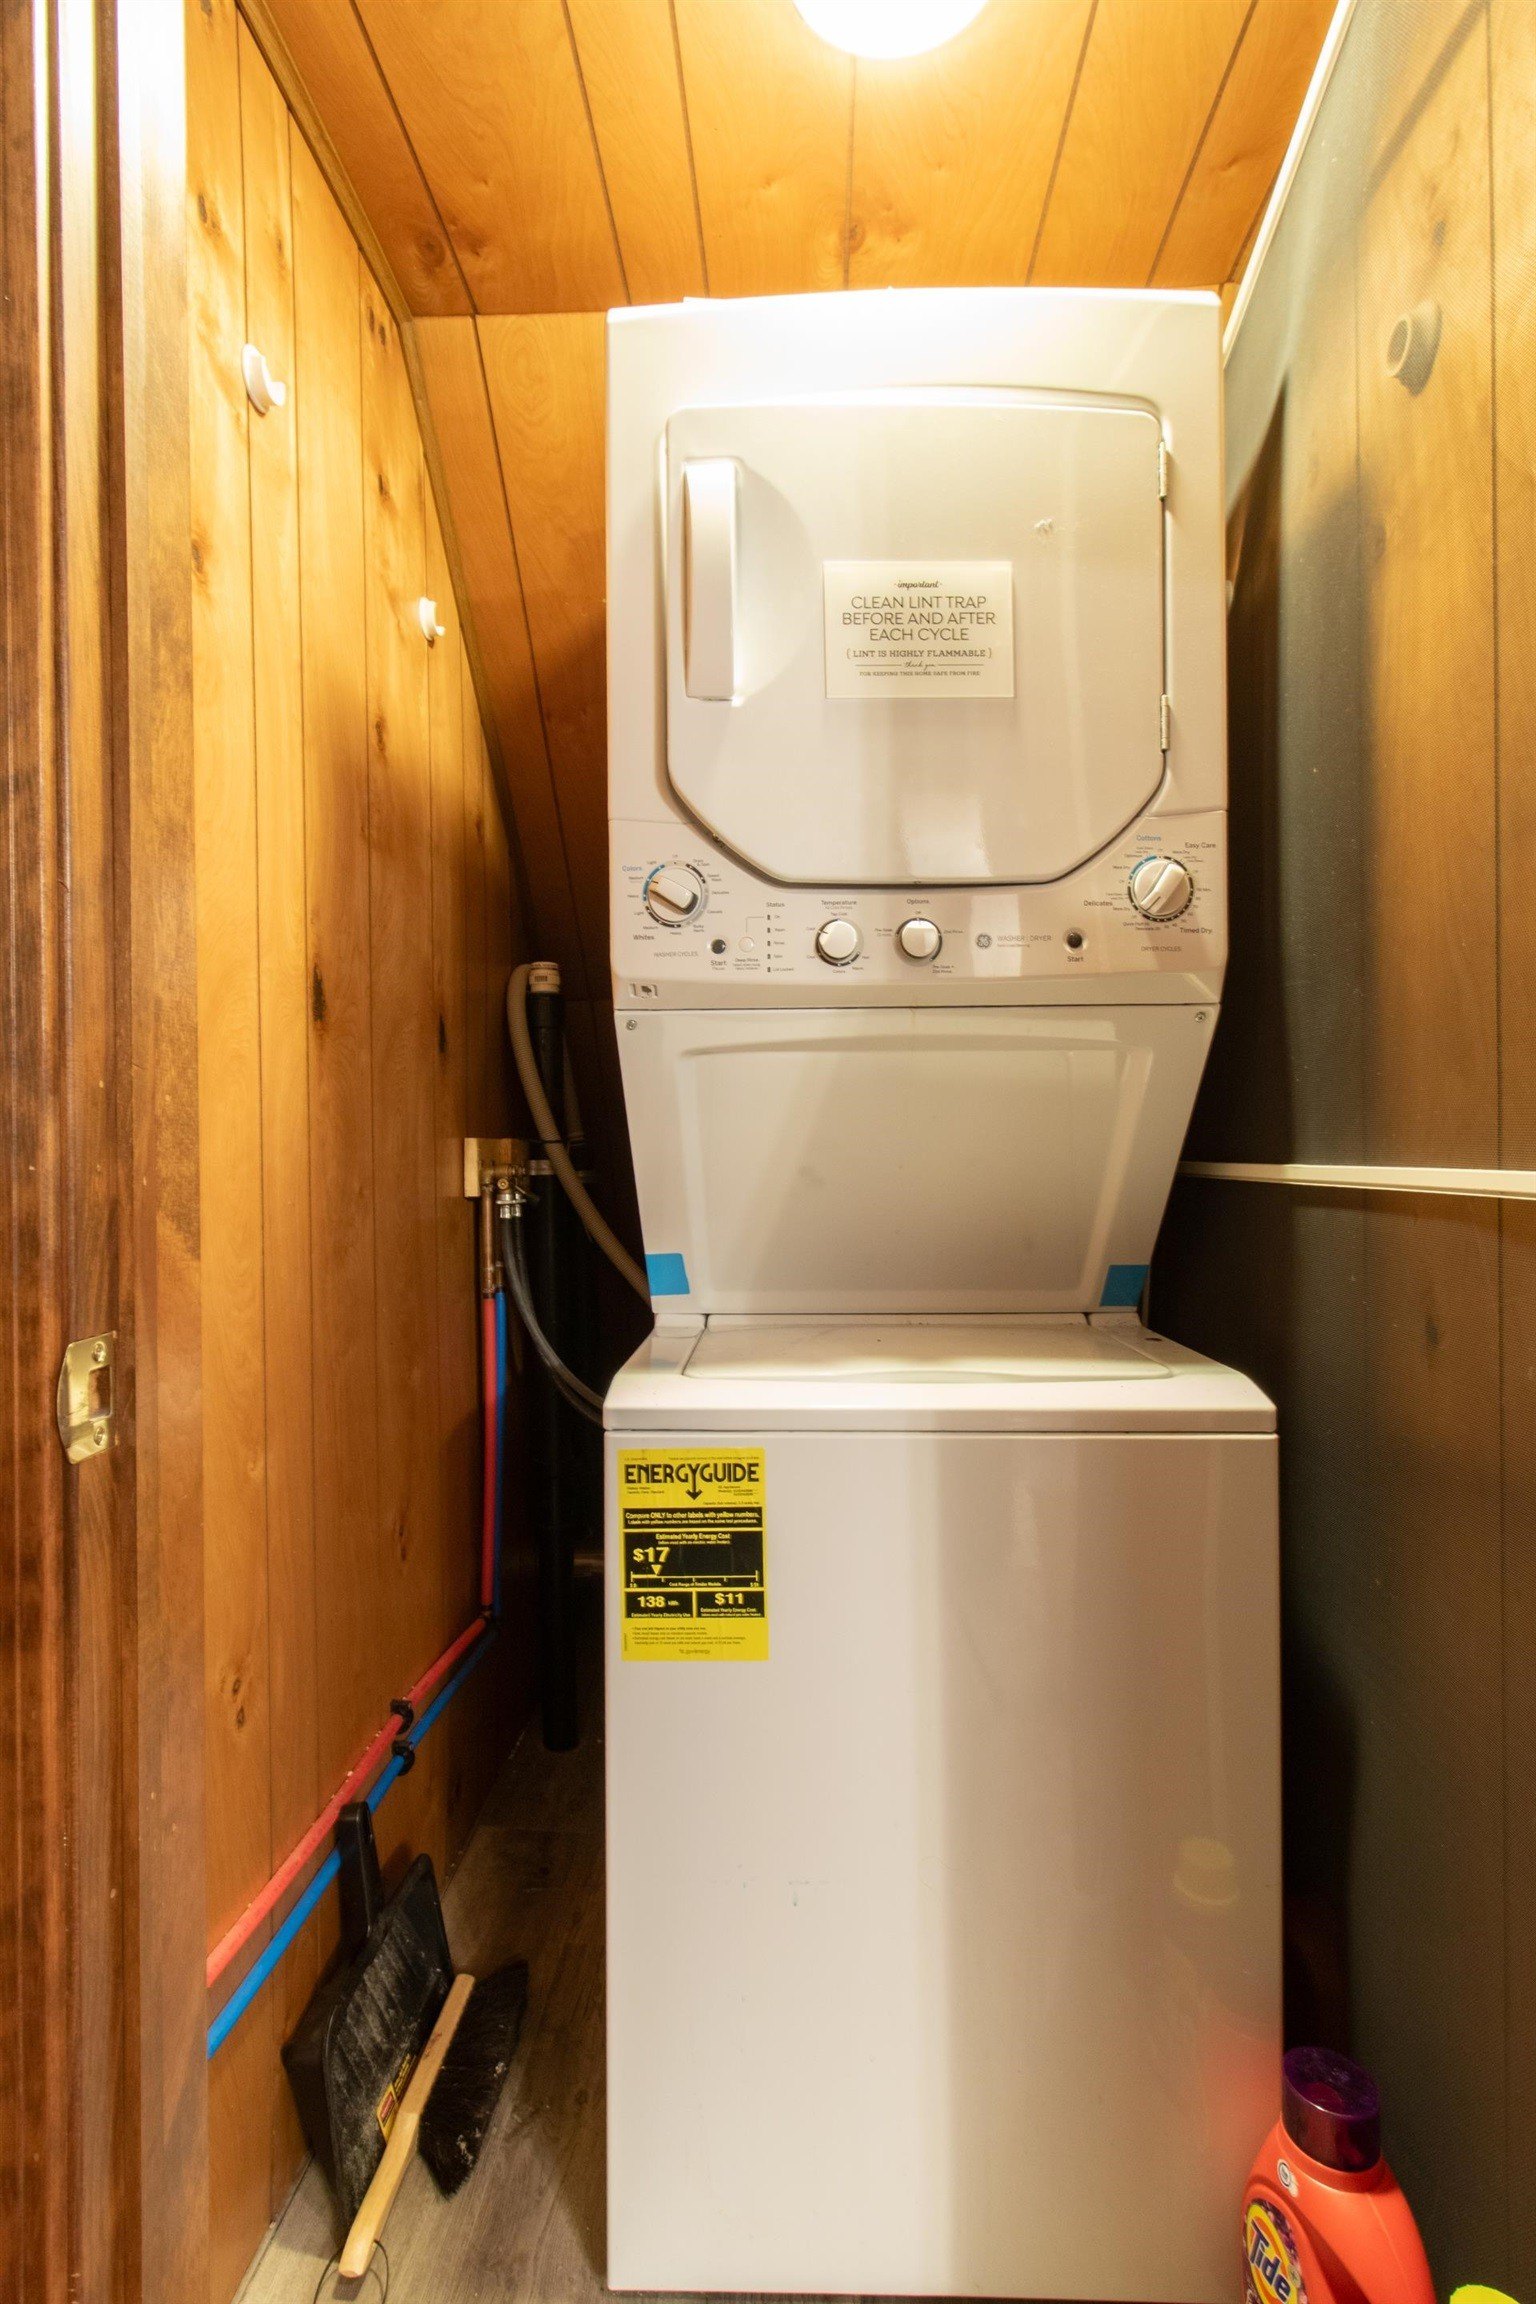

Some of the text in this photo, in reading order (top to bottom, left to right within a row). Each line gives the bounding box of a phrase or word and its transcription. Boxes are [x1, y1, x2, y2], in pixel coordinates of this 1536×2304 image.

[850, 596, 987, 609] CLEAN LINT TRAP
[842, 612, 996, 625] BEFORE AND AFTER
[869, 628, 970, 641] EACH CYCLE
[853, 649, 986, 658] LINT IS HIGHLY FLAMMABLE
[1184, 842, 1200, 850] Easy
[1067, 955, 1084, 963] Start
[624, 1463, 759, 1487] ENERGYGUIDE
[633, 1547, 670, 1563] $17
[637, 1596, 665, 1608] 138
[714, 1592, 744, 1606] $11
[1248, 2217, 1291, 2303] Tide
